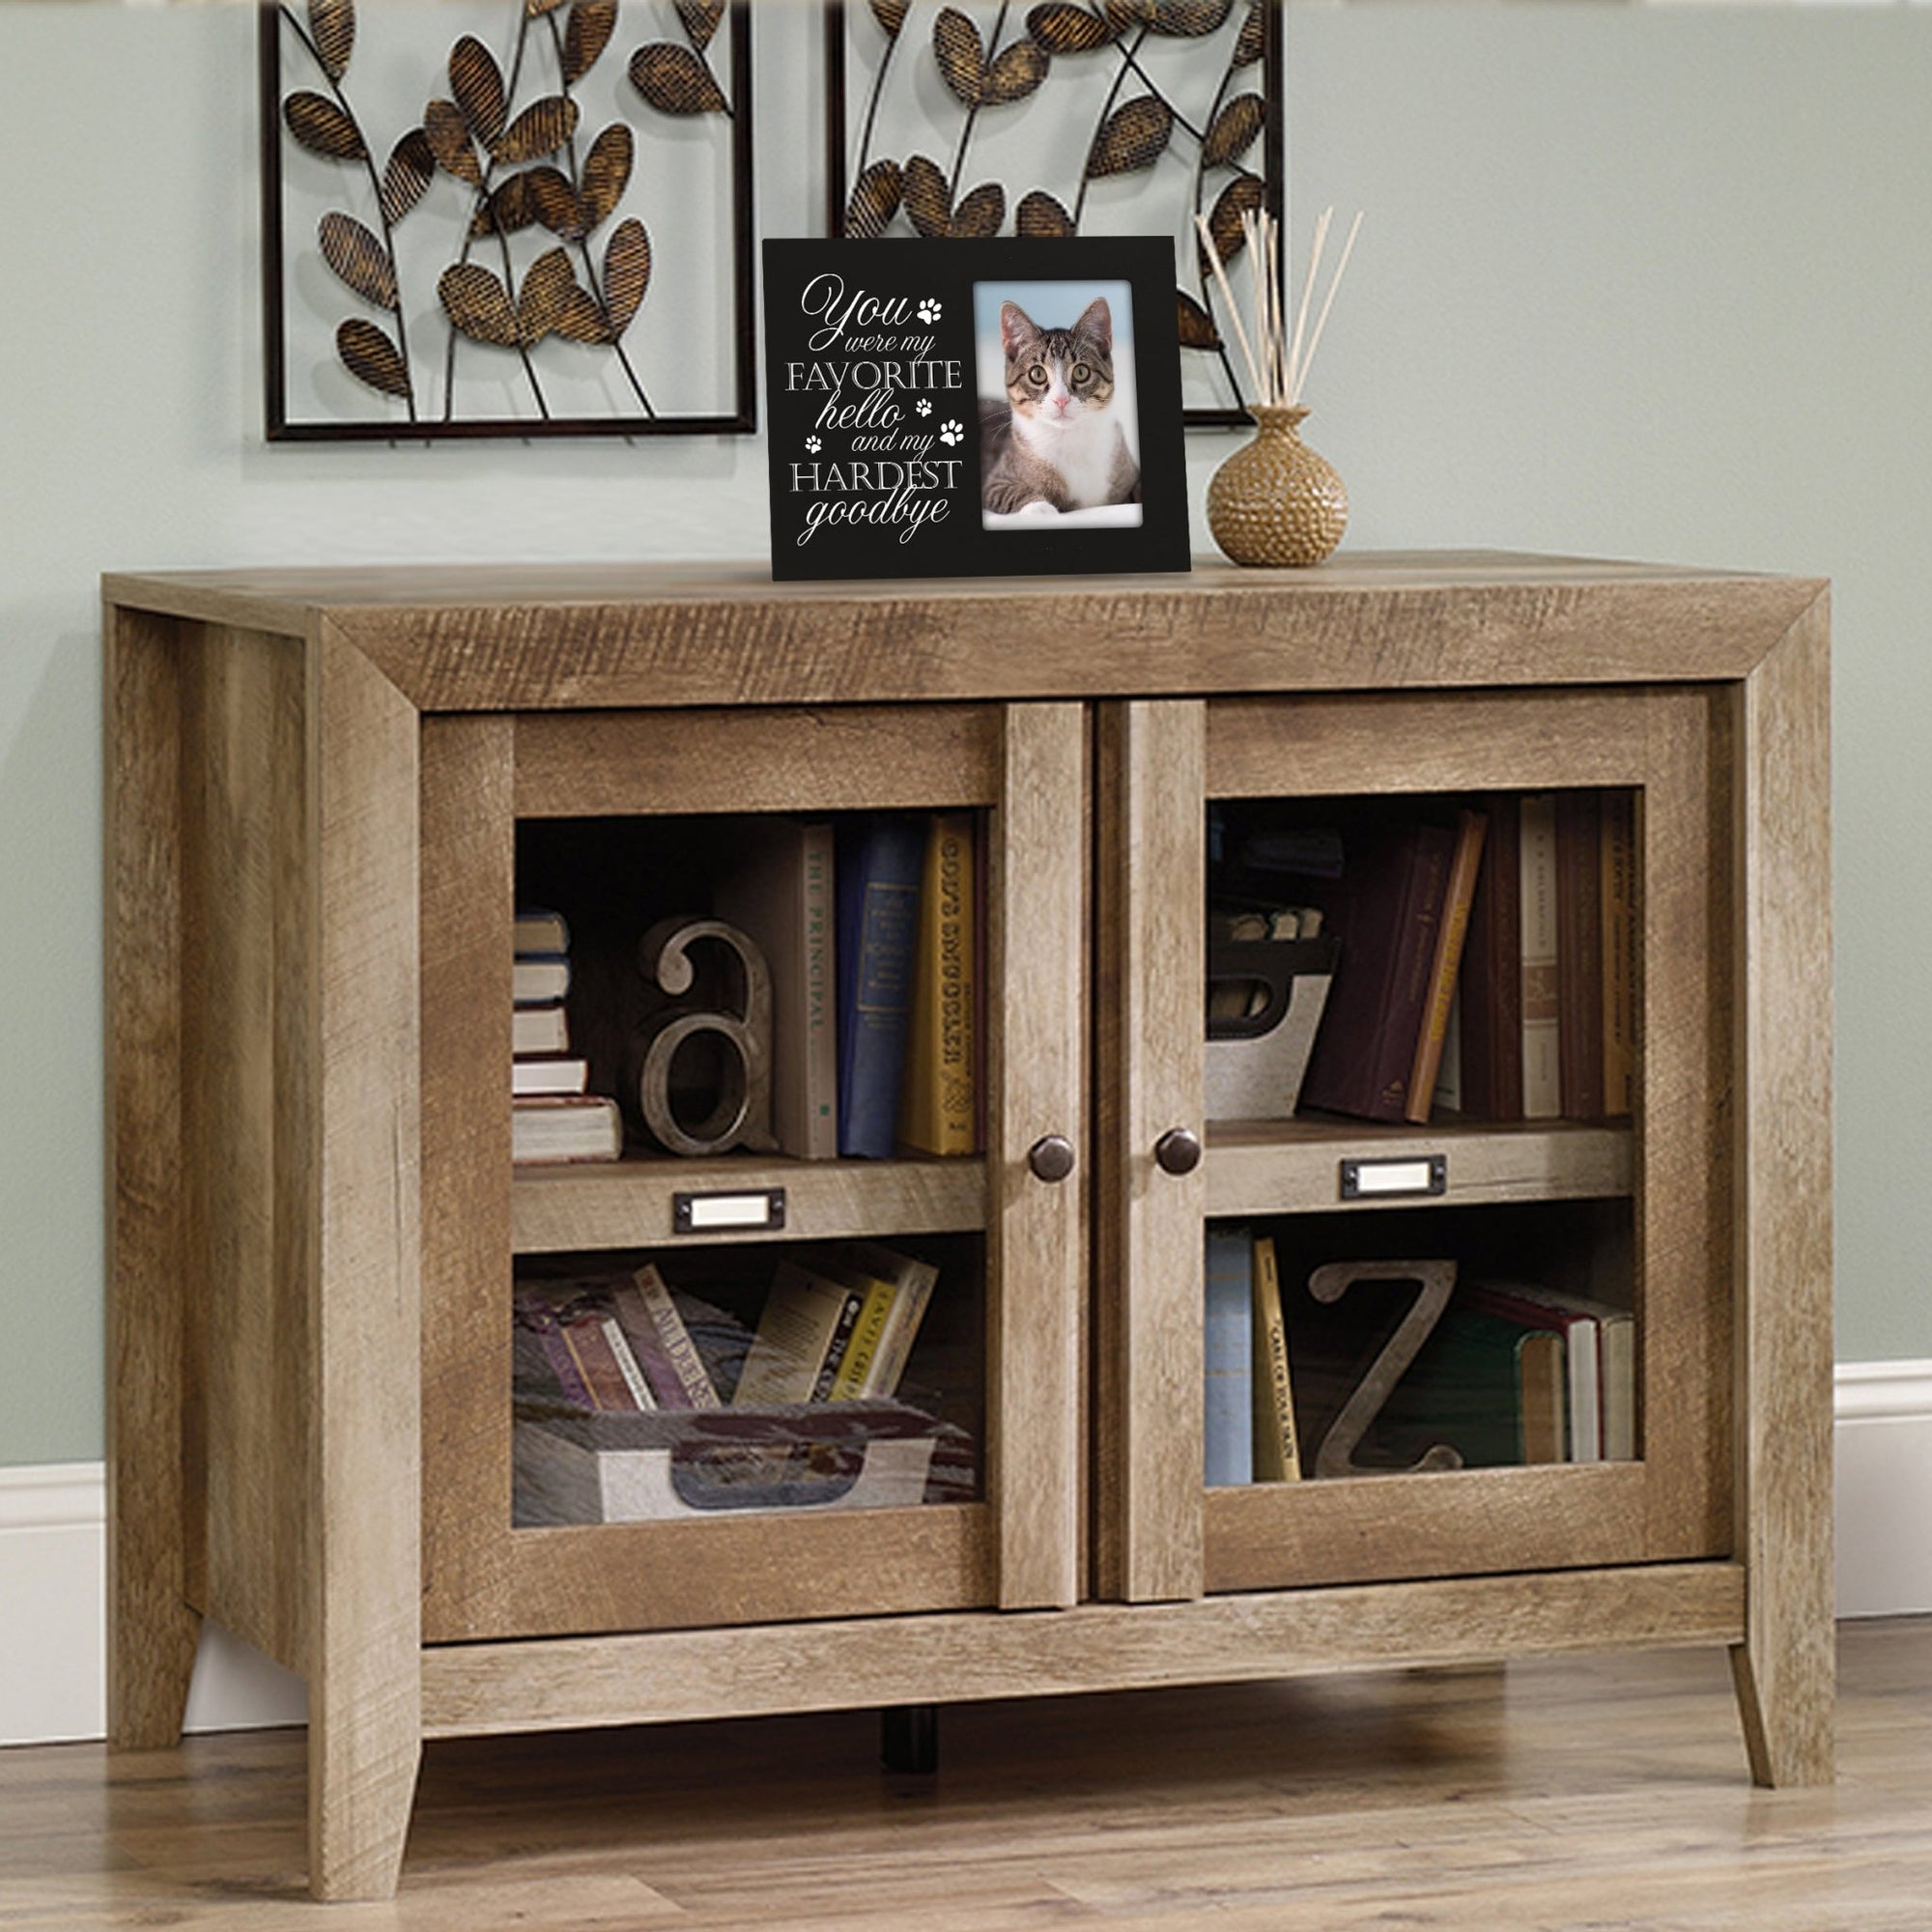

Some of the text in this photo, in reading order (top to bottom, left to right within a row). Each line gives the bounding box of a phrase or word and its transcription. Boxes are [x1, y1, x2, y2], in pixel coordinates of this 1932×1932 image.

[802, 273, 913, 351] You
[844, 334, 936, 367] were my
[784, 360, 962, 391] FAVORITE
[814, 387, 906, 430] hello
[851, 427, 936, 462] and my
[788, 460, 963, 493] HARDEST
[797, 484, 951, 547] goodbye
[807, 852, 821, 893] THE
[809, 905, 825, 1029] PRINCIPAL
